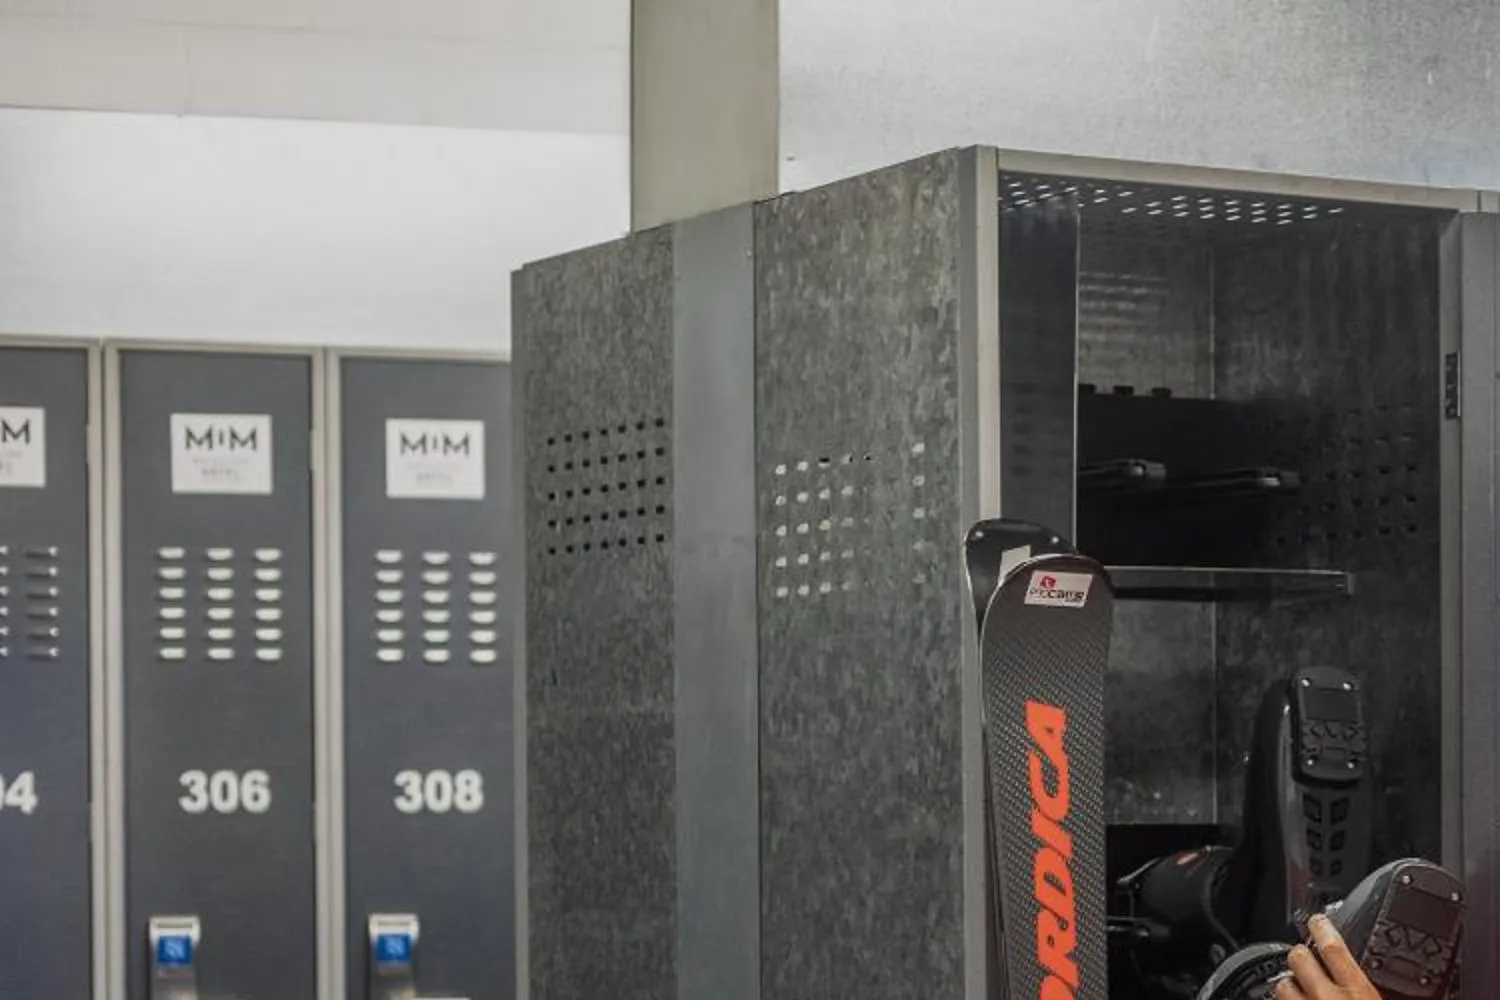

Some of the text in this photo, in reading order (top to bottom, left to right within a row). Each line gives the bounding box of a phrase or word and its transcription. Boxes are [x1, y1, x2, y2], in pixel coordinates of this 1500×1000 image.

[185, 424, 257, 452] MIM
[400, 431, 470, 458] MIM
[0, 770, 39, 815] 4
[178, 770, 271, 813] 306
[394, 770, 484, 813] 308
